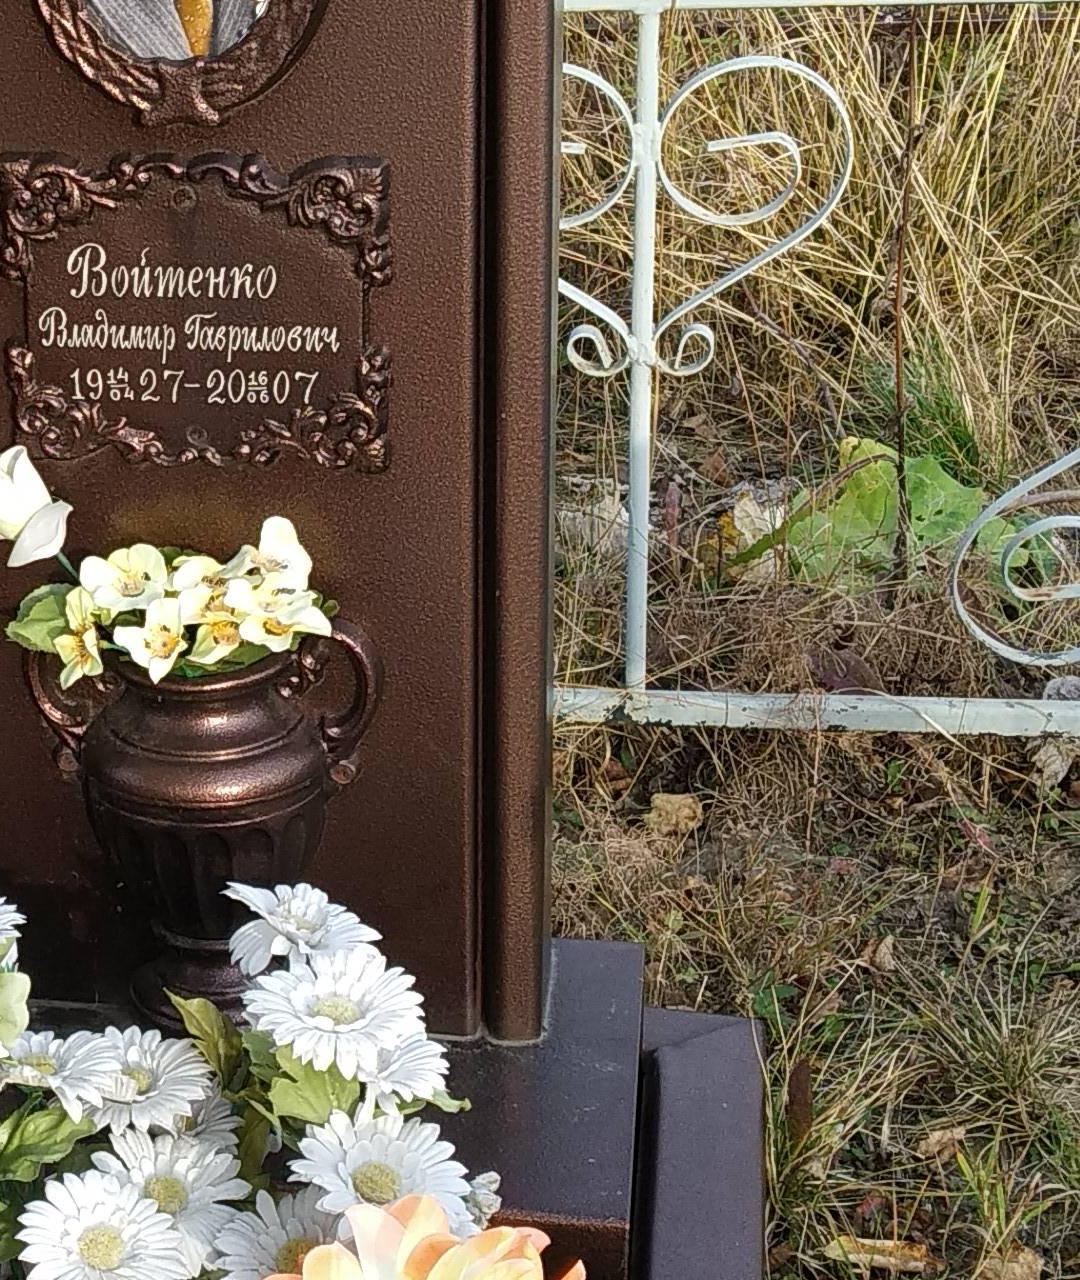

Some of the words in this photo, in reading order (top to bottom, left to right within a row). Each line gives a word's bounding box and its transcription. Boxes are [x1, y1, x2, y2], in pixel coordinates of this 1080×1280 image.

[67, 243, 277, 299] Войтенко
[38, 306, 176, 365] Владимир
[184, 311, 340, 363] Гаврилович
